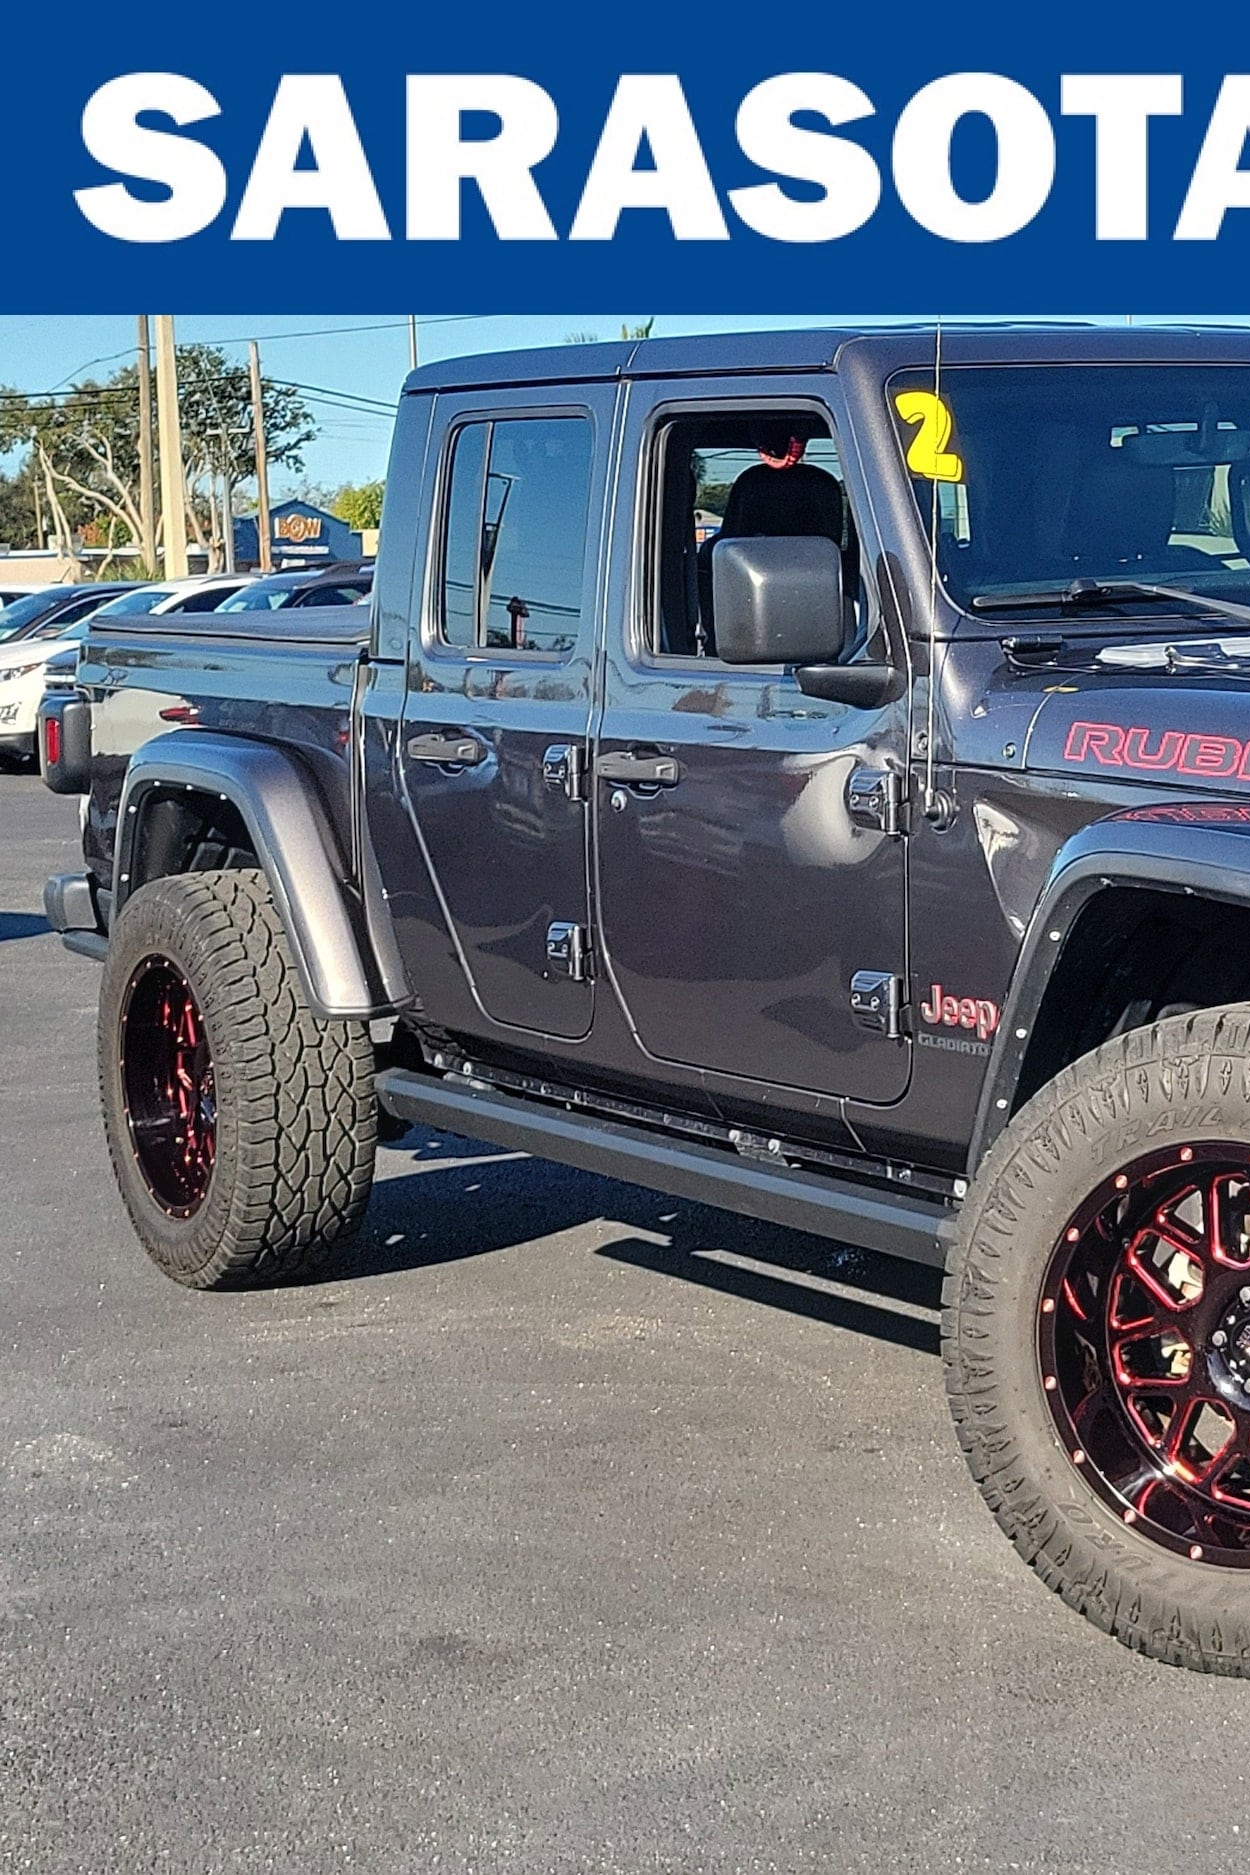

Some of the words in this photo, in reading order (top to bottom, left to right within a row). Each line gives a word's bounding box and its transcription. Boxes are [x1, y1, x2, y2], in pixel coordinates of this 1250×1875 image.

[895, 391, 963, 482] 2
[921, 984, 999, 1040] Jeep
[918, 1031, 990, 1056] GLADIATO
[1091, 1105, 1223, 1166] TRAIL
